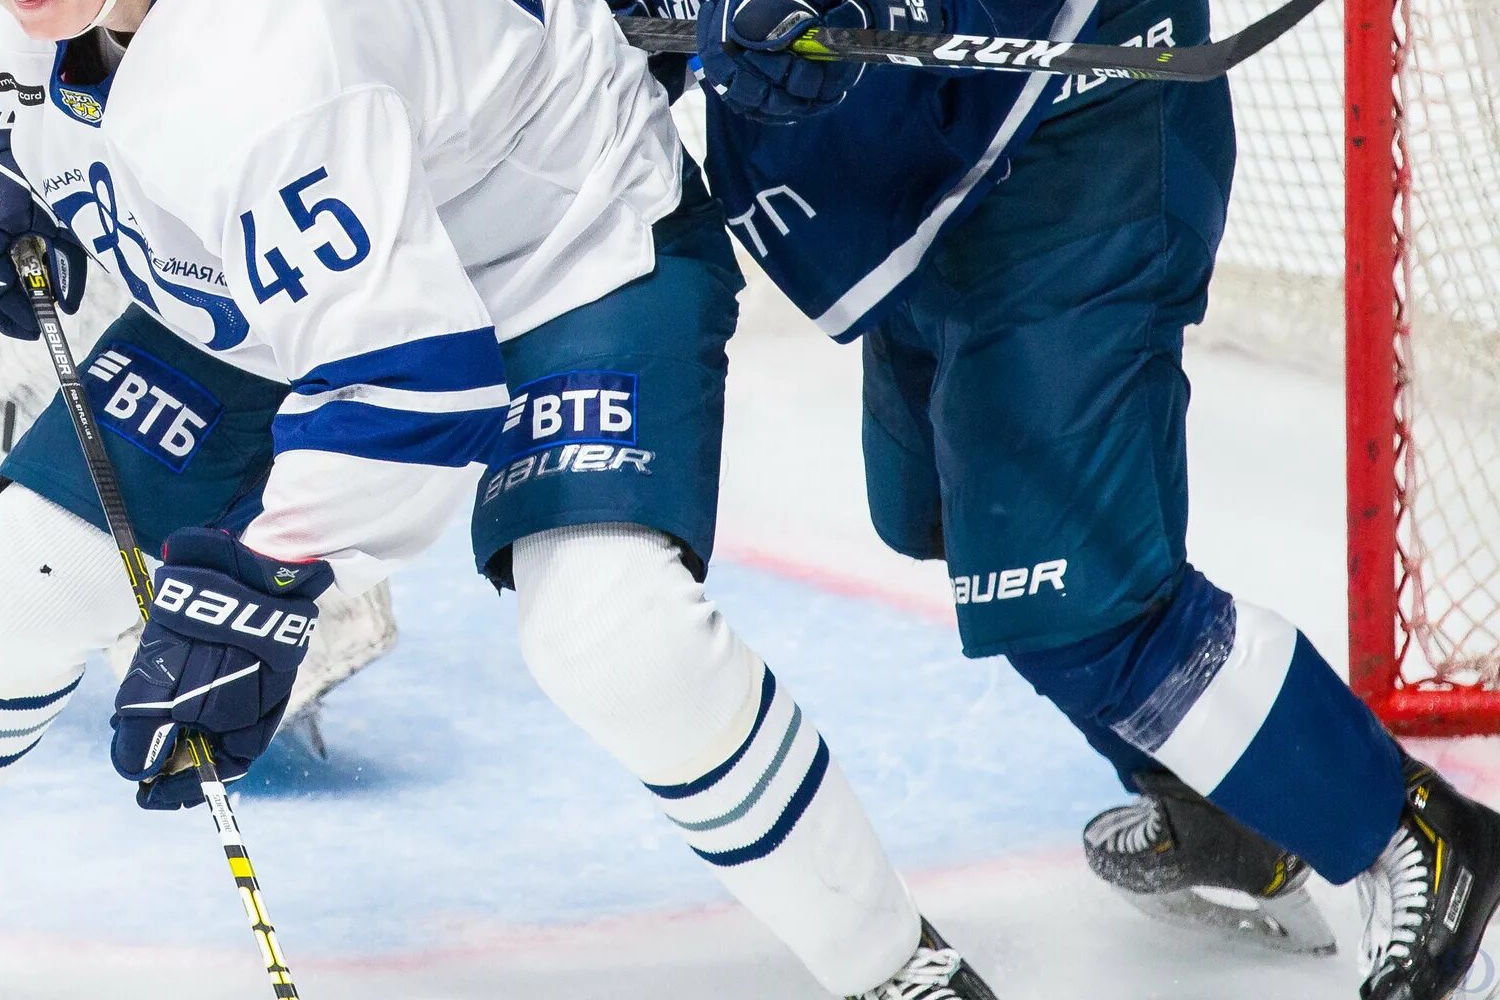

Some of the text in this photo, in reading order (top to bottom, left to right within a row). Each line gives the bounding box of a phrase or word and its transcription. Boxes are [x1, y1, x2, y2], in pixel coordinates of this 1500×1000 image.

[932, 34, 1074, 69] CCM
[239, 166, 372, 305] 45
[44, 322, 72, 375] BAUER
[78, 411, 89, 426] FLEX
[103, 371, 208, 457] ВТБ
[532, 388, 633, 440] ВТБ
[481, 443, 657, 508] BAUER
[950, 558, 1068, 604] AUER
[153, 577, 320, 648] BAUER
